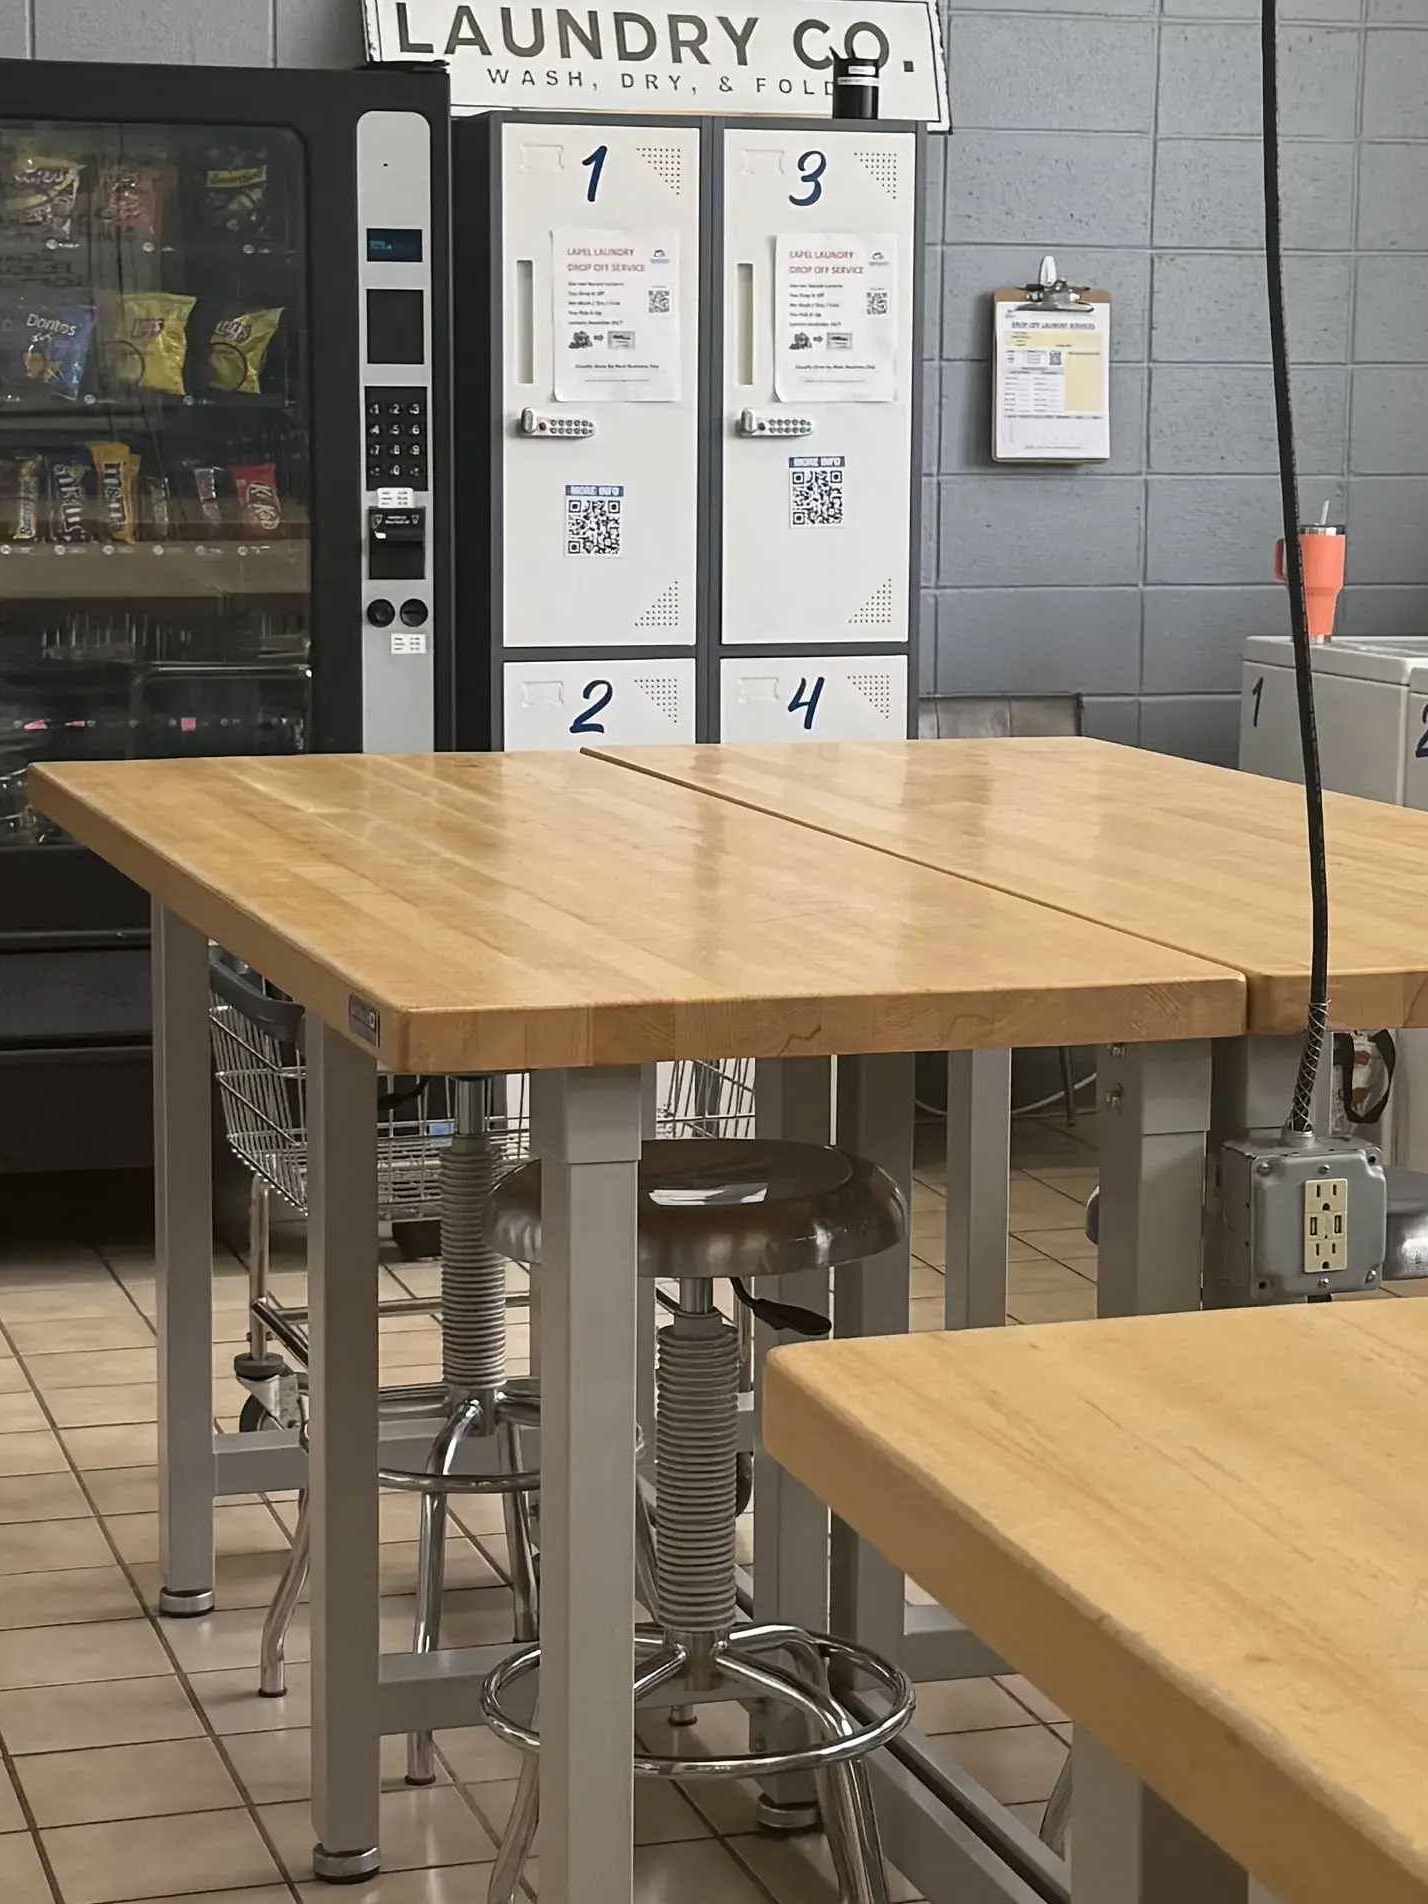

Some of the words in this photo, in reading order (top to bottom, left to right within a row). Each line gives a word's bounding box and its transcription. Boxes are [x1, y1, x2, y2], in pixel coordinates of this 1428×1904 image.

[395, 2, 758, 67] LAUNDRY
[793, 18, 915, 73] CO.
[487, 68, 599, 91] WASH,
[622, 72, 698, 96] DRY,
[719, 75, 734, 92] &
[581, 145, 609, 202] 1
[788, 149, 827, 206] 3
[567, 248, 591, 256] LAPEL
[594, 248, 635, 256] LAUNDRY
[568, 264, 591, 272] DROP
[593, 264, 608, 272] OFF
[612, 264, 645, 272] SERVICE
[832, 266, 864, 274] SERVICE
[393, 403, 400, 414] 2
[412, 403, 420, 414] 3
[371, 424, 380, 435] 4
[393, 424, 400, 435] 5
[412, 424, 420, 435] 6
[393, 444, 400, 455] 8
[412, 444, 420, 455] 9
[393, 464, 400, 476] 0
[569, 680, 613, 734] 2
[787, 676, 824, 731] 4
[1250, 676, 1263, 728] 1
